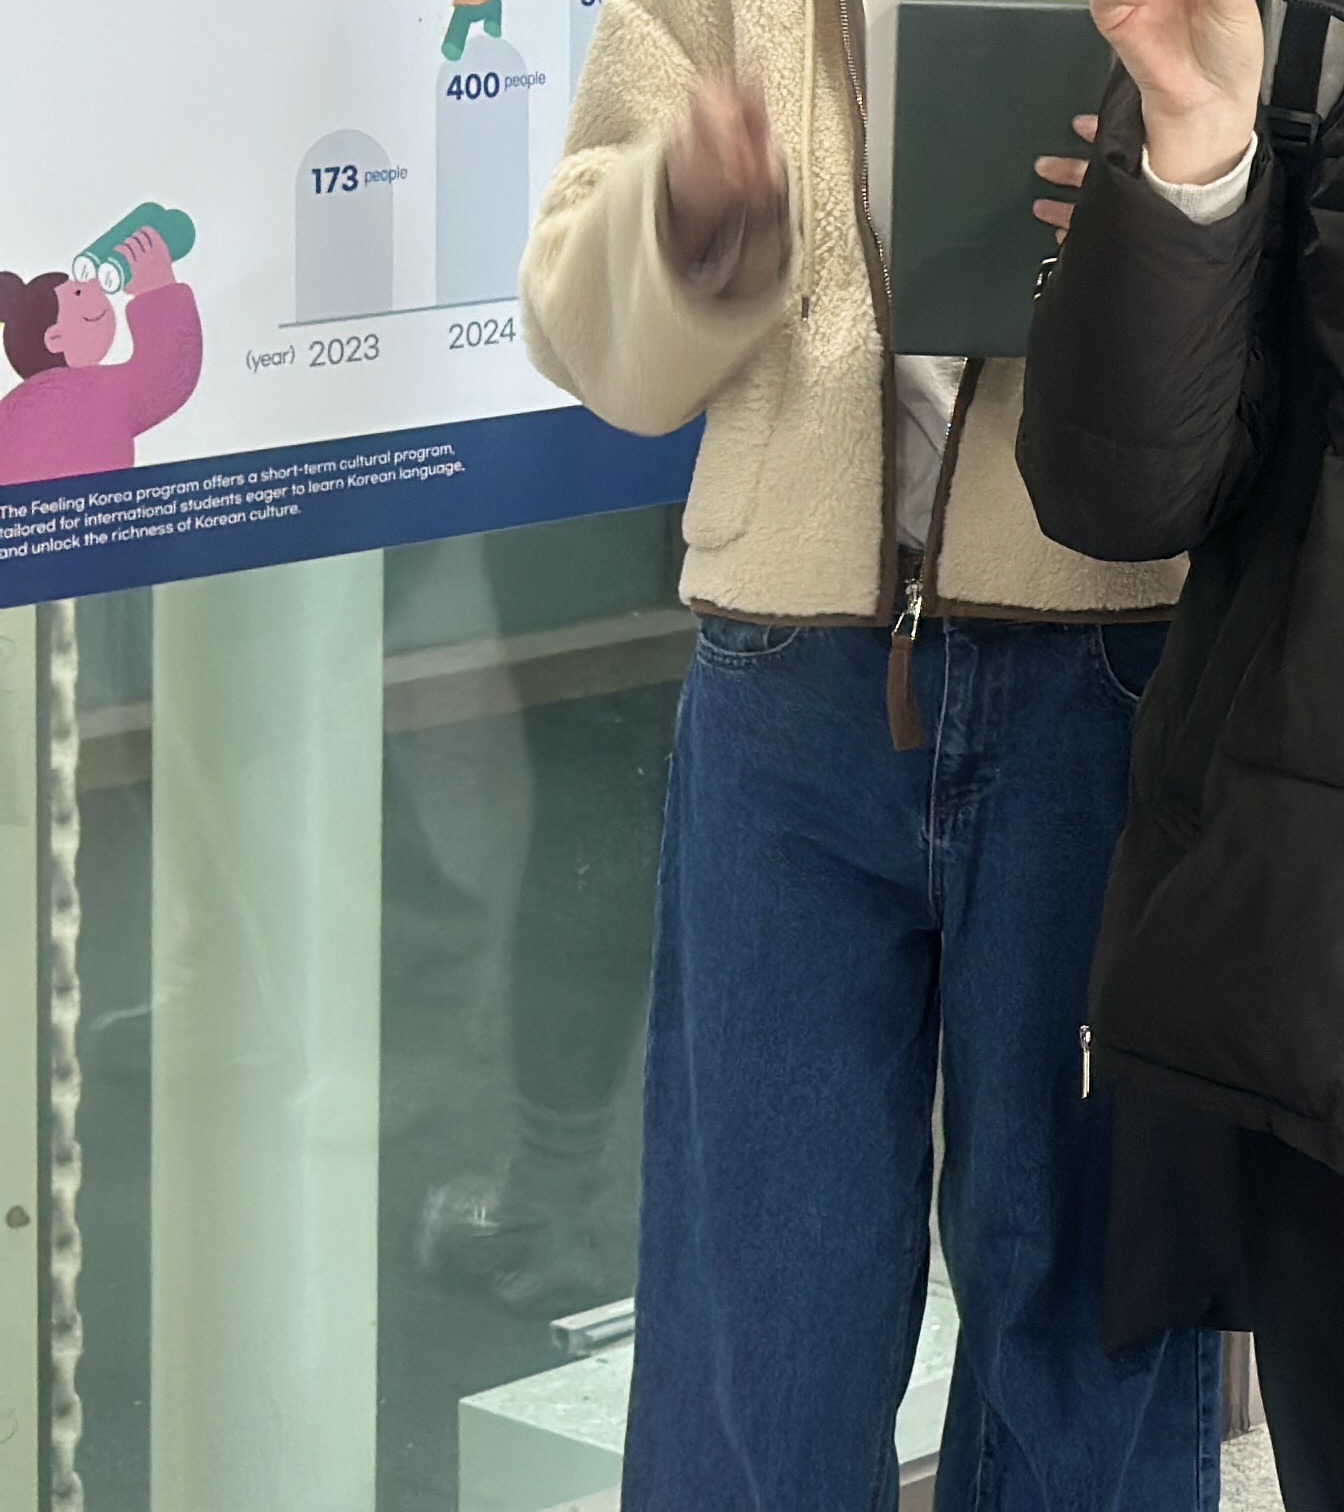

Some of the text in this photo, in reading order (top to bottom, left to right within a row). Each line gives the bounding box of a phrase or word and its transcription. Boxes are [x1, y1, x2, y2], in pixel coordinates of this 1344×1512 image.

[446, 69, 547, 101] 400 people
[311, 163, 408, 194] 173 people
[246, 317, 516, 372] (year) 2023 2024
[0, 444, 455, 520] The Feeling Korea program offers a short-term cultural program,
[0, 460, 465, 540] tailored for international students eager to learn Korean language.
[0, 504, 302, 560] and unlock the richness of Korean culture.
